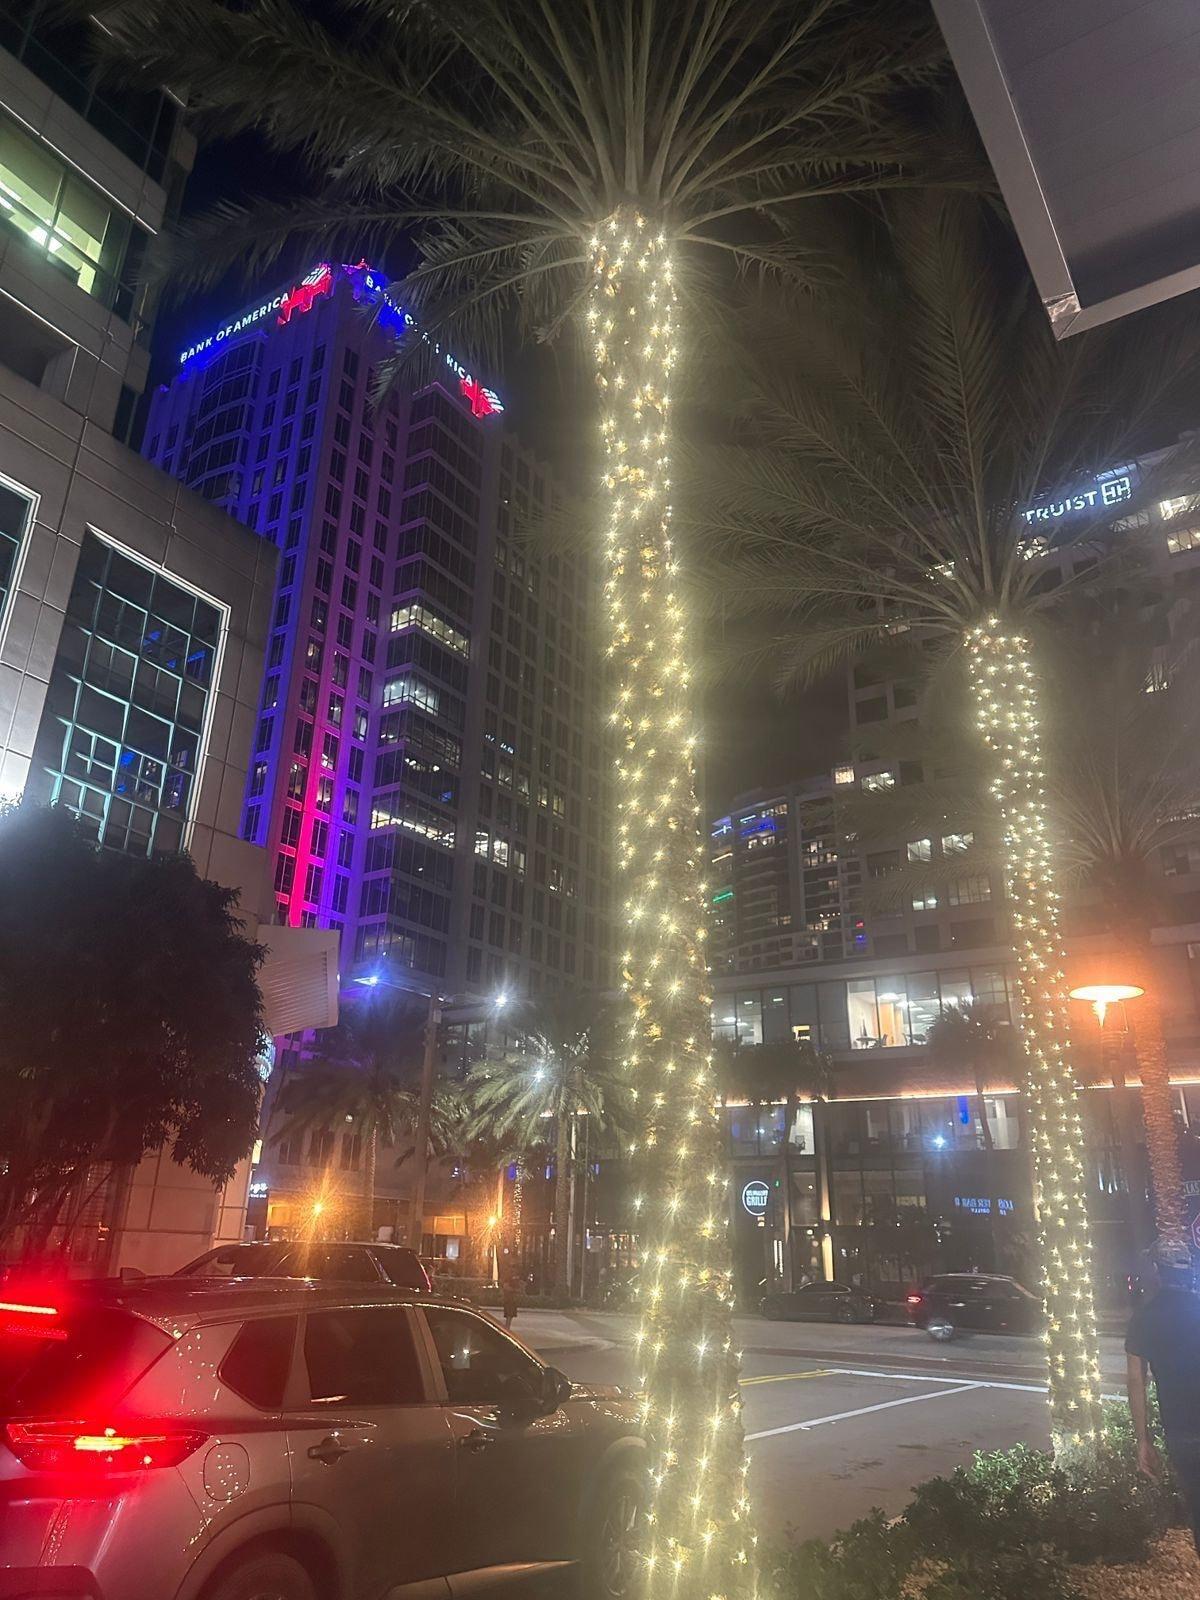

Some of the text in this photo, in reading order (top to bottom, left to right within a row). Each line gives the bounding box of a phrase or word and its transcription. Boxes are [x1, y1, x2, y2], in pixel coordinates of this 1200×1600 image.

[180, 292, 290, 364] BANK OF AMERICA
[1021, 490, 1098, 525] TRUIST
